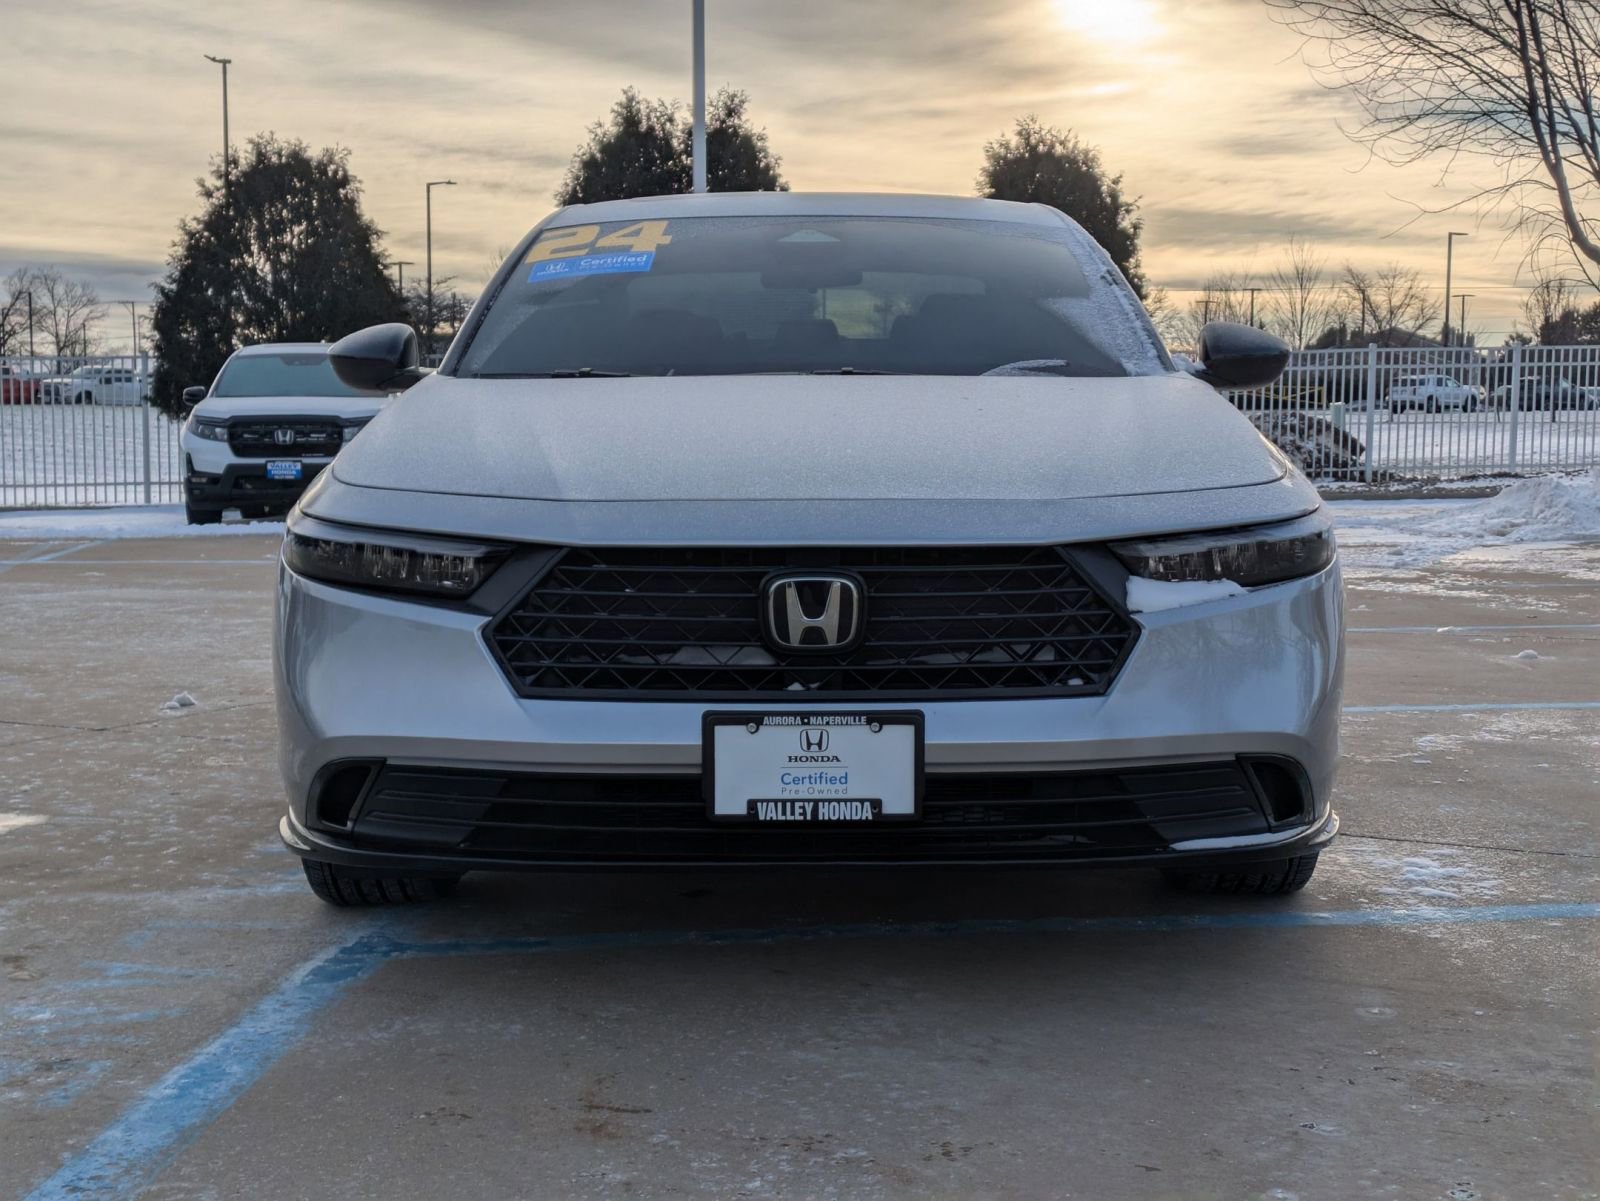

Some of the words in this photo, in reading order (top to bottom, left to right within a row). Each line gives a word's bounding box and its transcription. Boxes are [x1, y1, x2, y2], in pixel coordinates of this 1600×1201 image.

[525, 220, 672, 264] 24
[581, 254, 648, 266] Certified
[763, 716, 802, 725] AURORA
[809, 716, 867, 725] NAPERVILLE
[787, 755, 841, 763] HONDA
[780, 772, 848, 785] Certified
[781, 787, 848, 795] Pre-Owned
[757, 802, 814, 820] VALLEY
[818, 802, 873, 820] HONDA
